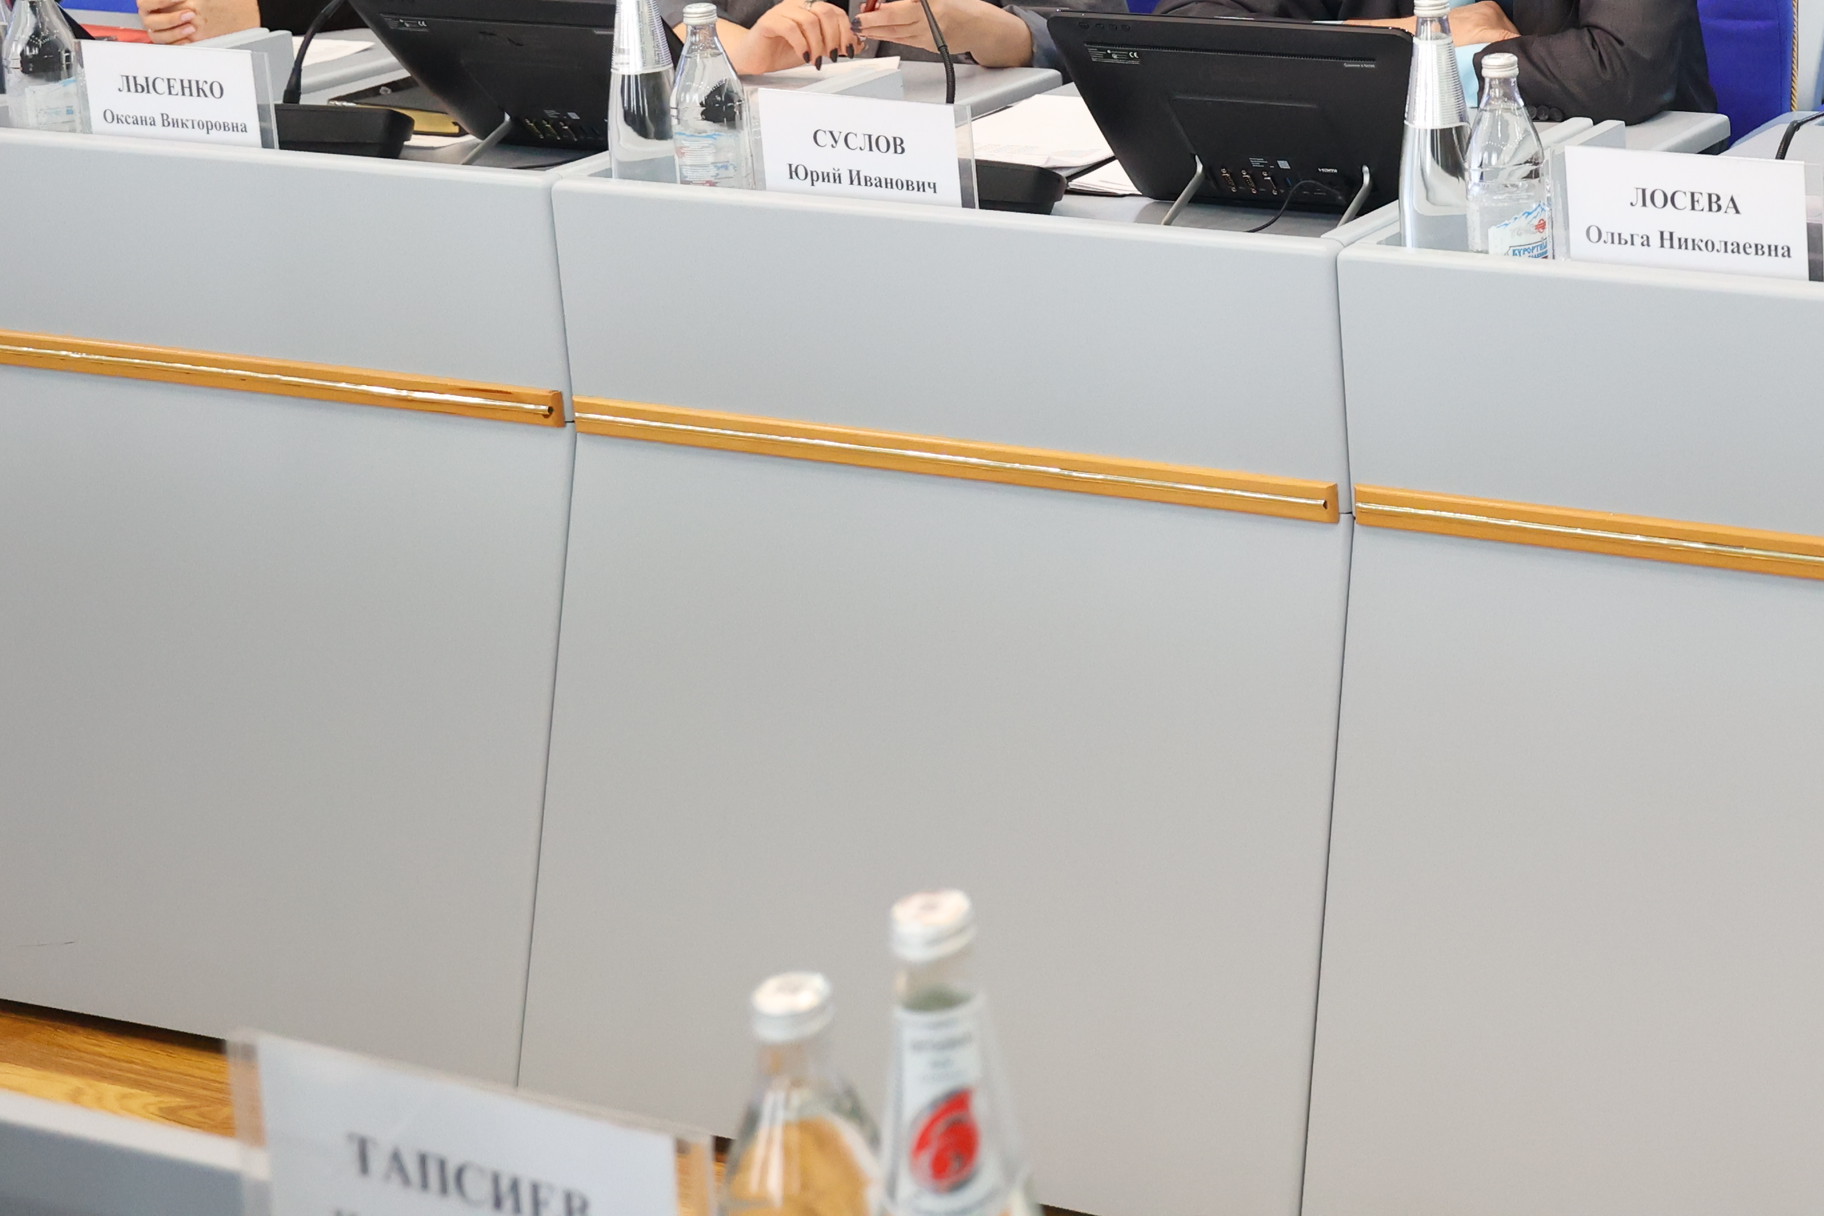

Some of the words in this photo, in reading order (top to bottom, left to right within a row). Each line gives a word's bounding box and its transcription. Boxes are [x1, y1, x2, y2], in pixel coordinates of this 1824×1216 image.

[118, 74, 224, 99] ЛЫСЕНКО
[103, 108, 157, 127] Оксана
[160, 112, 248, 134] Викторовна
[812, 128, 906, 155] СУСЛОВ
[787, 163, 843, 187] Юрий
[847, 168, 938, 194] Иванович
[1629, 186, 1742, 215] ЛОСЕВА
[1585, 224, 1651, 248] Ольга
[1658, 230, 1792, 259] Николаевна
